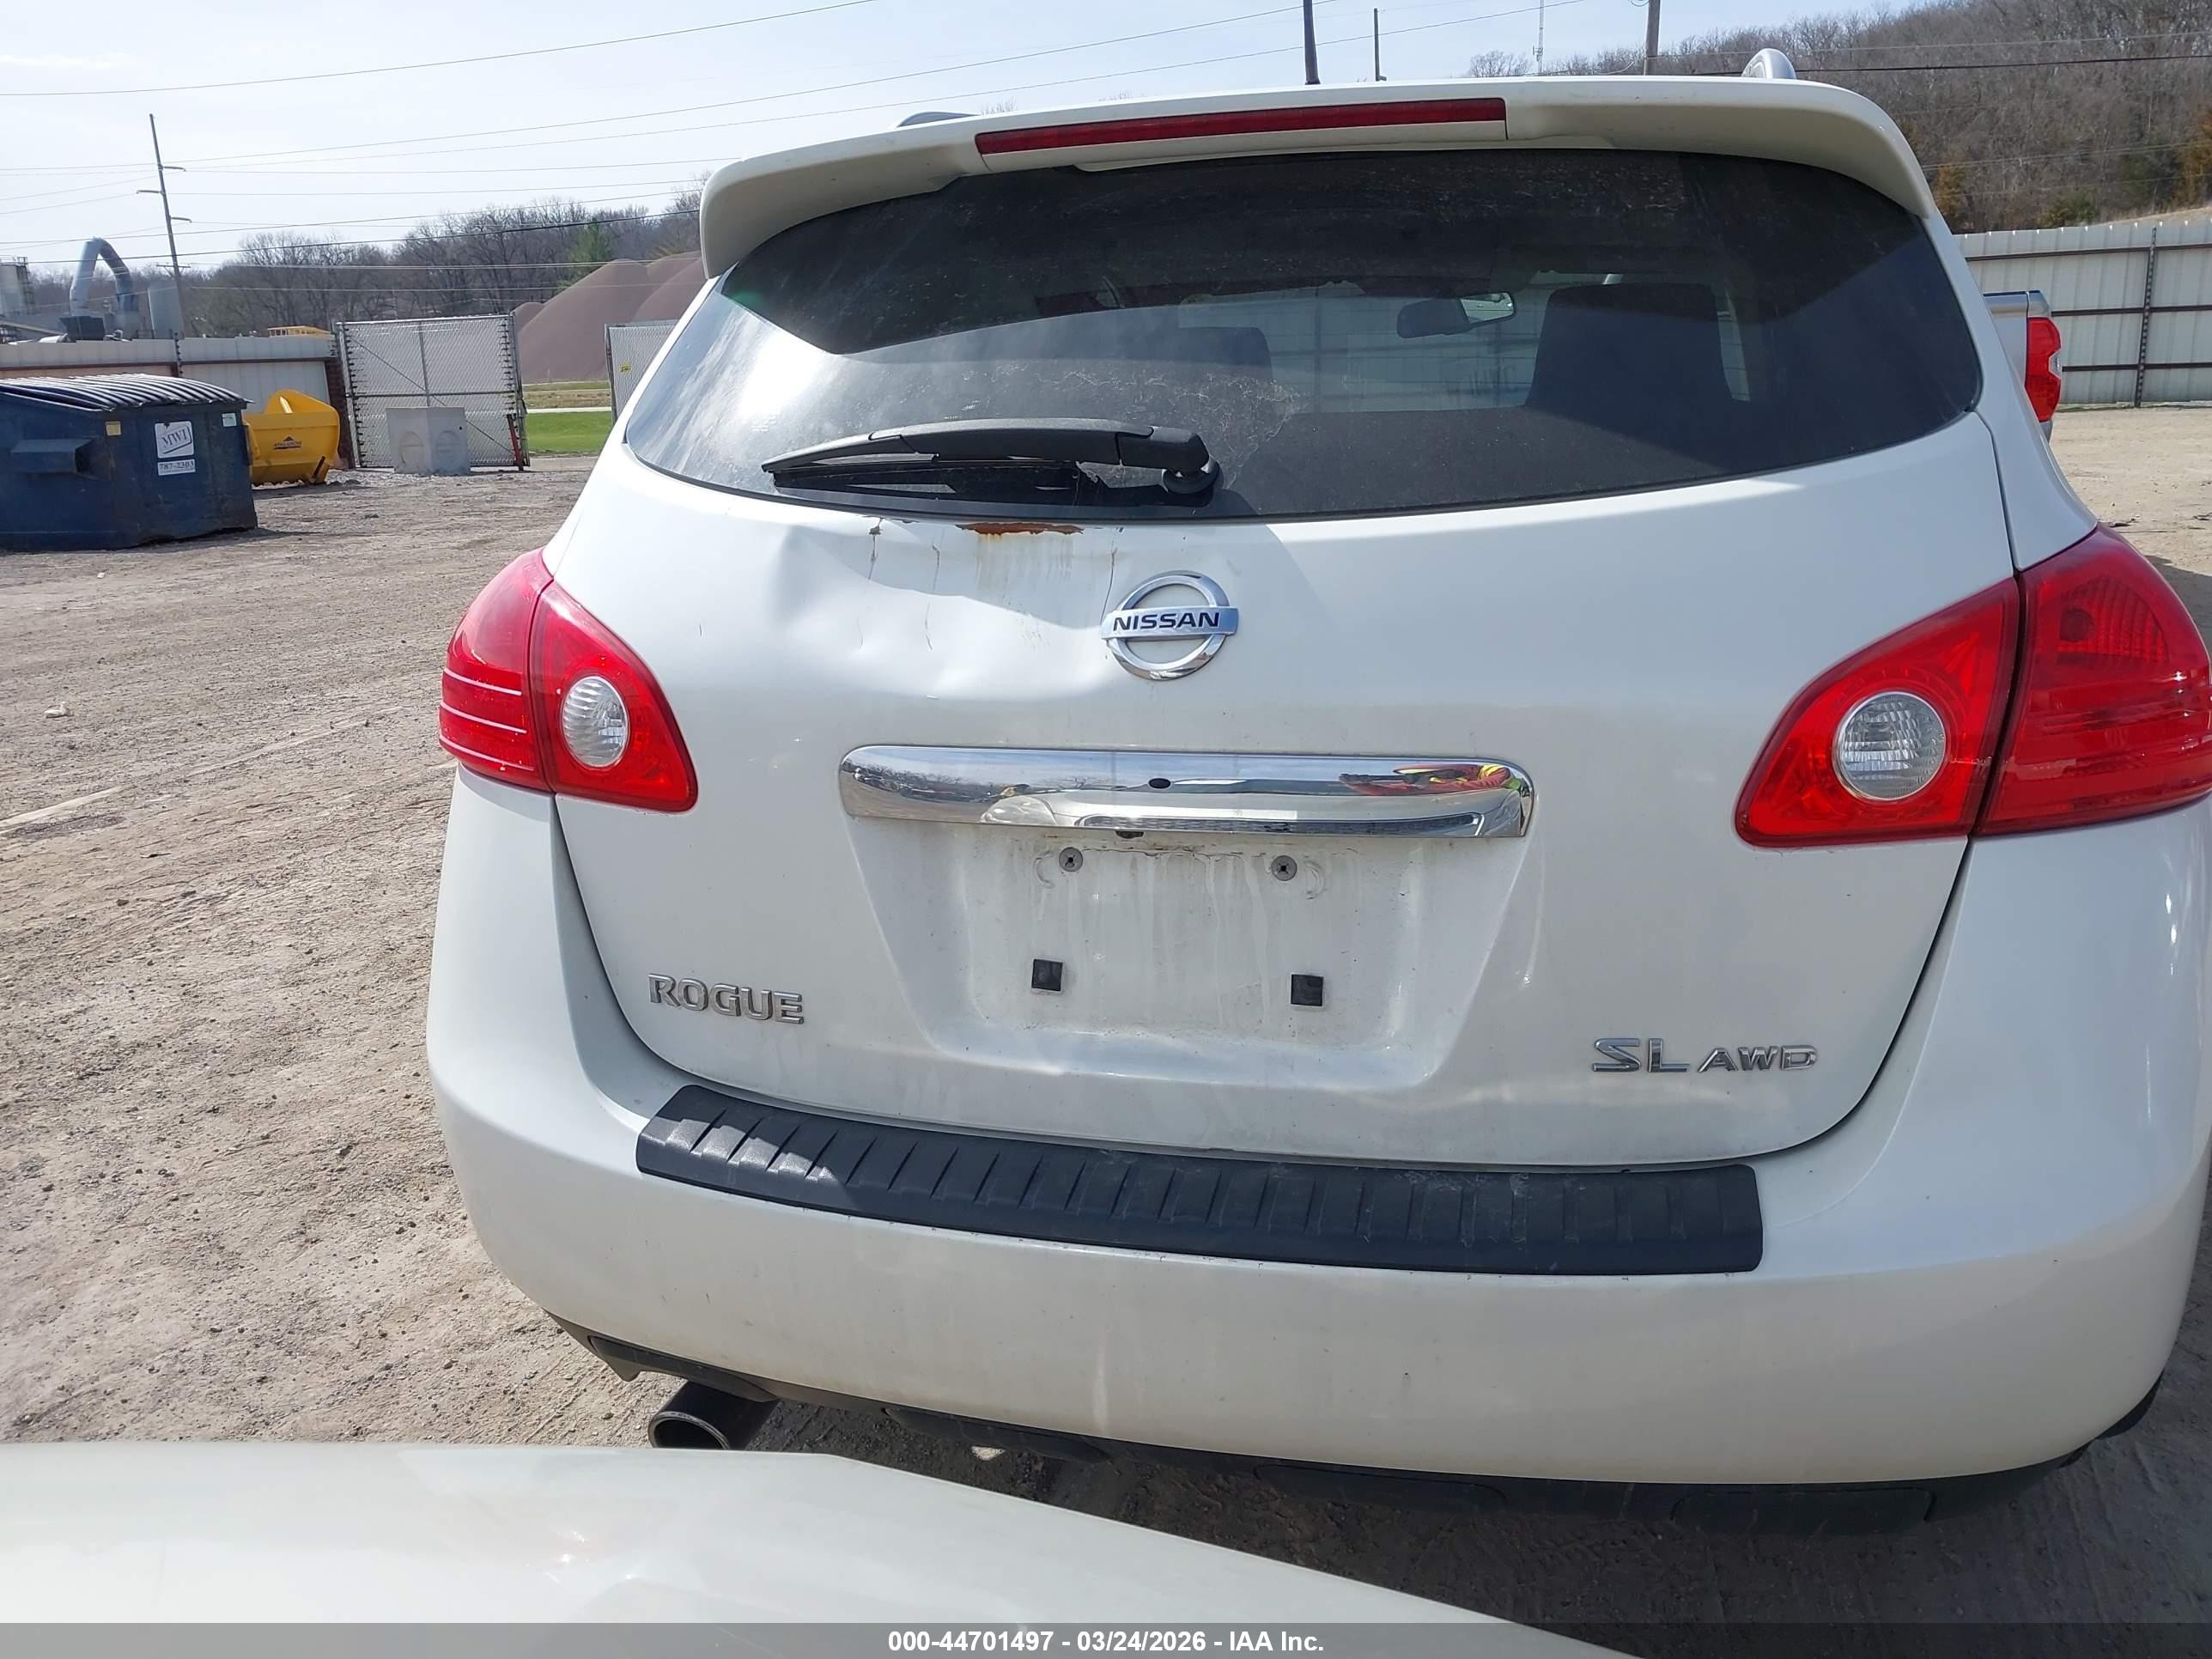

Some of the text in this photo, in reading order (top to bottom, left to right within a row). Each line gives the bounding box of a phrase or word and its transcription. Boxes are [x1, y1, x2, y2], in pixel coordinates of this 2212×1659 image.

[161, 428, 187, 447] MWI
[1113, 612, 1220, 632] NISSAN
[648, 973, 805, 1024] ROGUE
[1592, 1038, 1818, 1073] SL AWD
